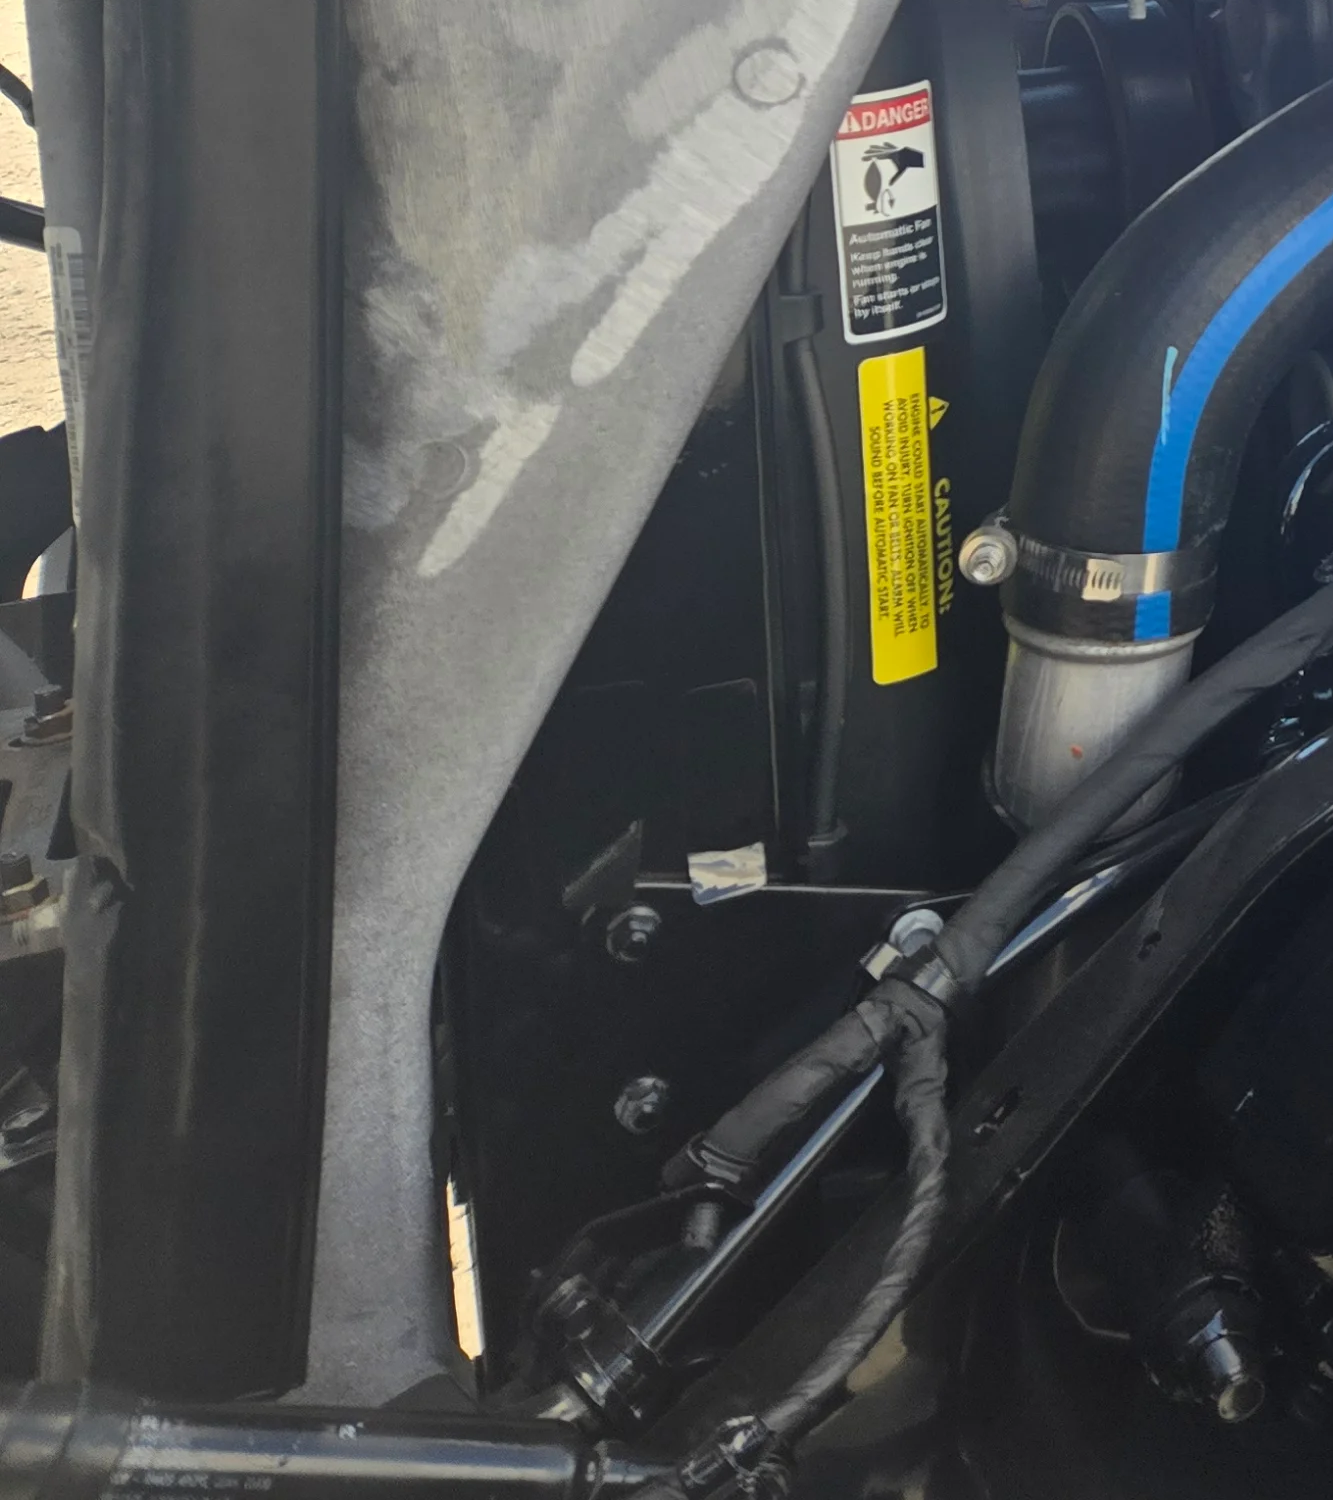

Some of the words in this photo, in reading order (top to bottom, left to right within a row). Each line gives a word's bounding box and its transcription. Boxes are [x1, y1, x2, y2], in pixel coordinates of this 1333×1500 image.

[861, 97, 929, 132] DANGER
[849, 224, 915, 245] Automatic
[850, 251, 881, 262] Keep
[882, 243, 915, 257] hands
[851, 263, 882, 276] when
[884, 255, 918, 269] engine
[853, 294, 876, 306] Fan
[854, 307, 871, 320] by
[883, 400, 896, 459] WORKING
[897, 398, 908, 434] AVOID
[910, 393, 920, 437] ENGINE
[869, 426, 883, 468] SOUND
[912, 440, 923, 479] COULD
[885, 462, 897, 481] ON
[872, 471, 885, 513] BEFORE
[887, 485, 899, 509] FAN
[901, 483, 912, 514] TURN
[914, 482, 926, 514] START
[888, 511, 900, 529] OR
[874, 517, 888, 584] AUTOMATIC
[903, 517, 915, 570] IGNITION
[934, 477, 954, 615] CAUTION:
[892, 569, 904, 608] ALARM
[905, 573, 917, 593] OFF
[894, 610, 905, 638] WILL
[907, 596, 918, 634] WHEN
[920, 613, 930, 629] TO
